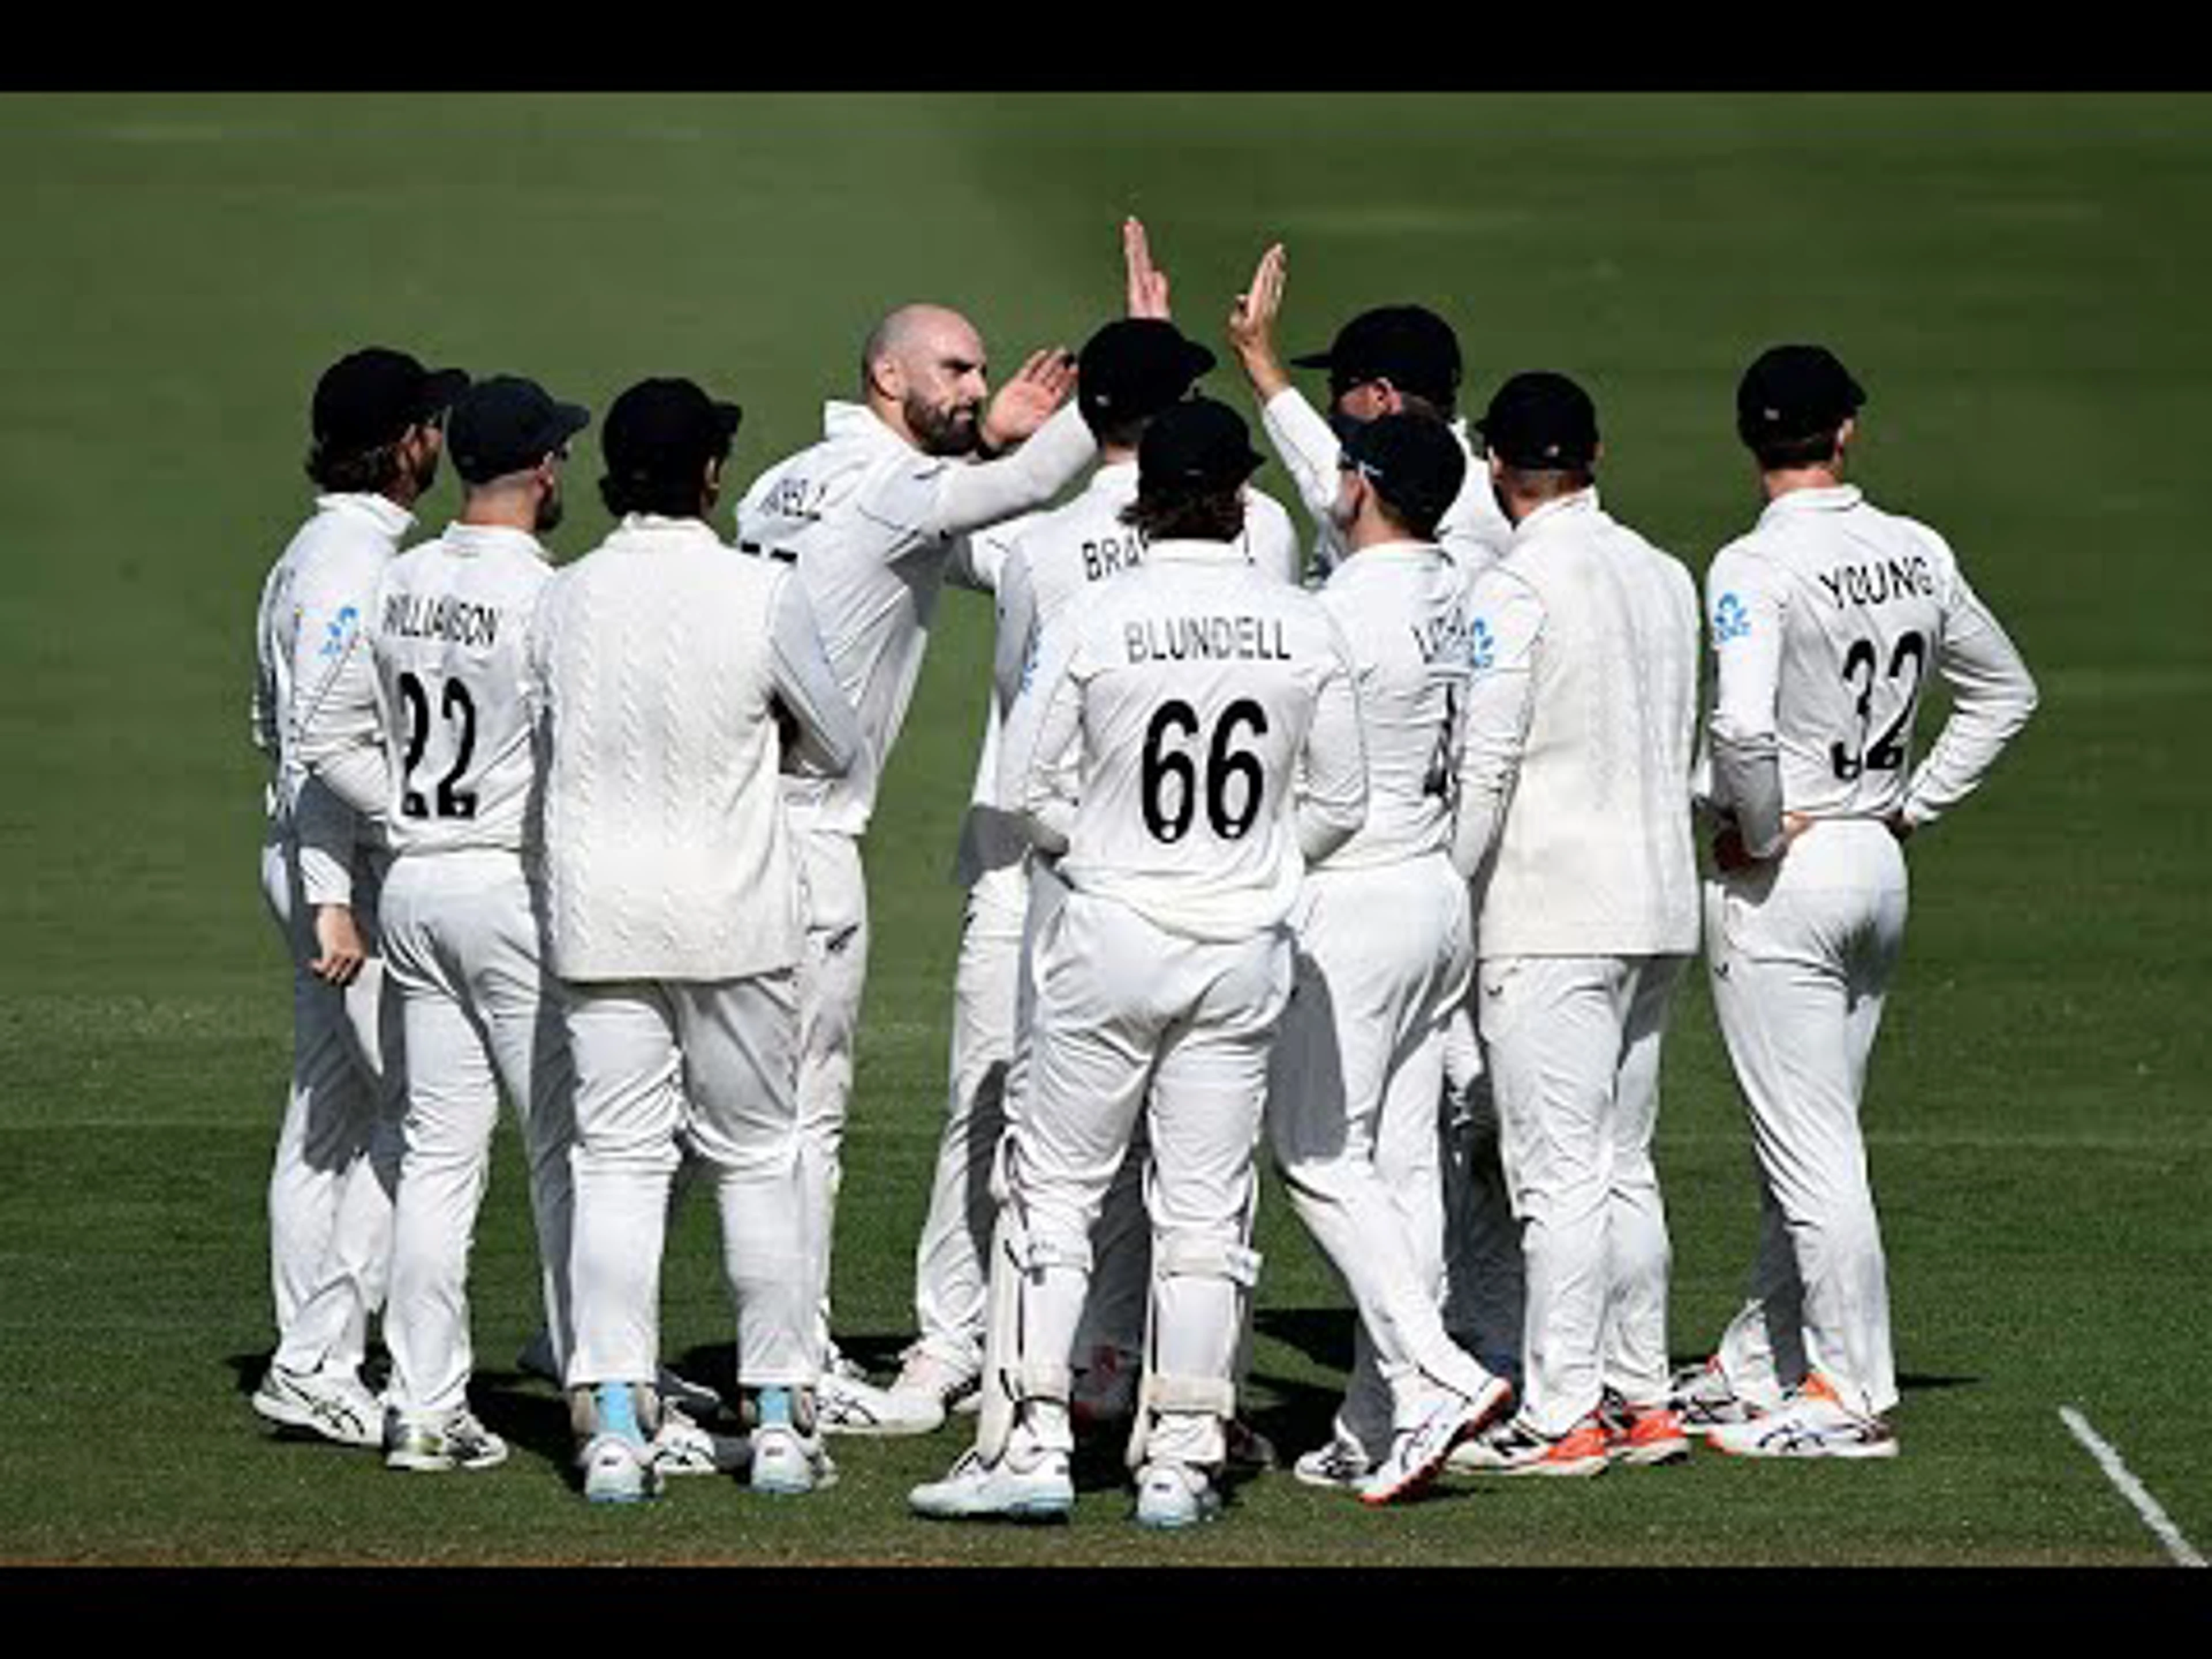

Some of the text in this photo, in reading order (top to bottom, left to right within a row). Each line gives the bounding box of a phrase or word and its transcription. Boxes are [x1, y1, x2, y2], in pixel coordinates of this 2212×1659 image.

[1820, 556, 1931, 608] YOUNG
[1125, 617, 1290, 663] BLUNDELL
[399, 672, 475, 819] 22
[1142, 699, 1267, 843] 66
